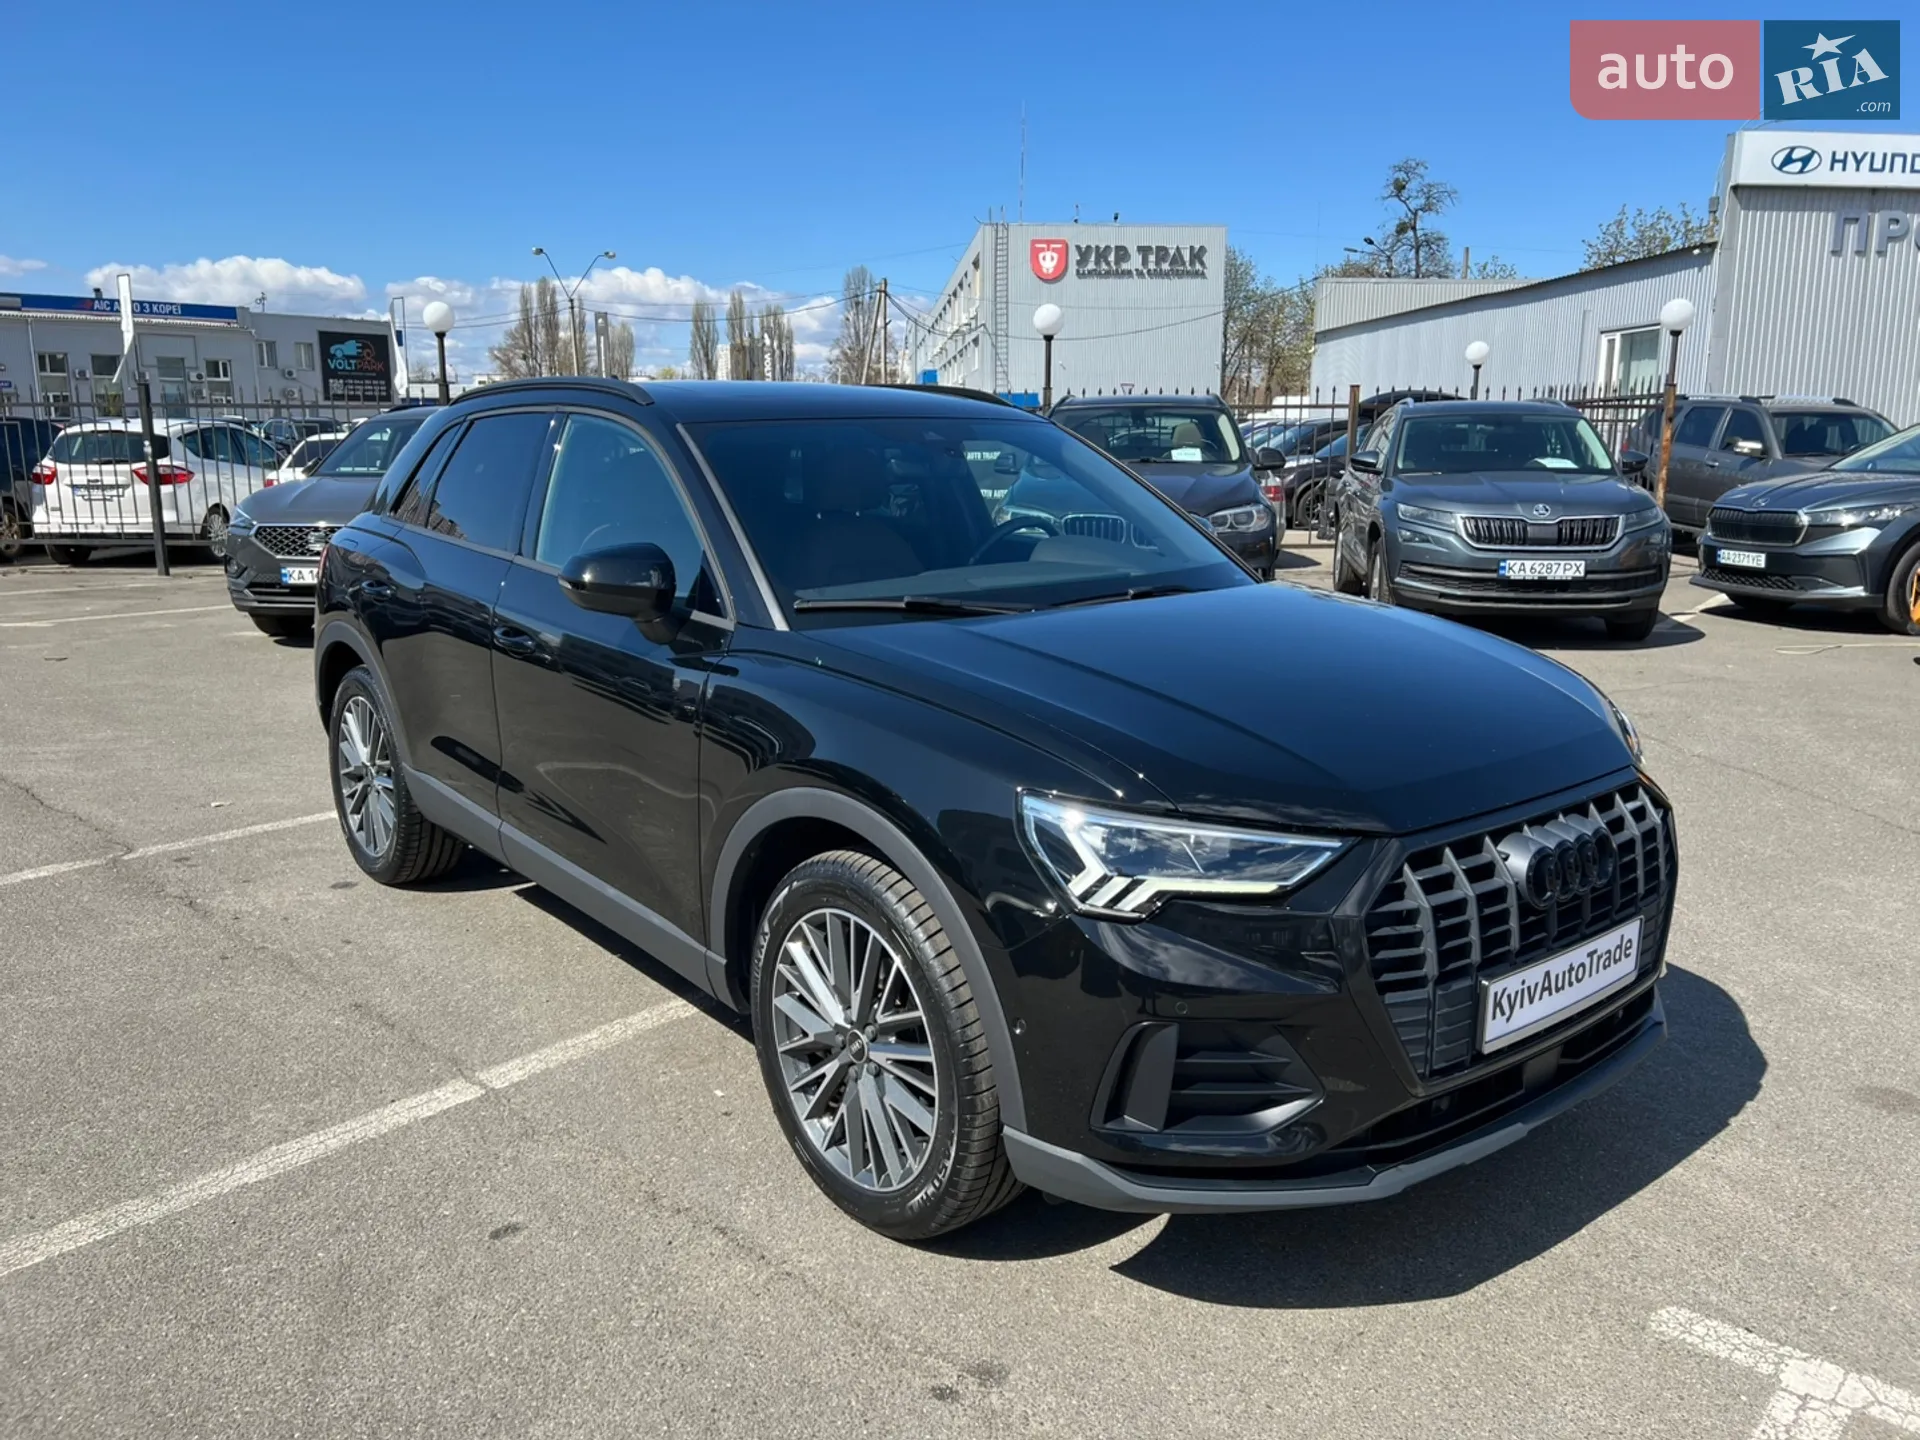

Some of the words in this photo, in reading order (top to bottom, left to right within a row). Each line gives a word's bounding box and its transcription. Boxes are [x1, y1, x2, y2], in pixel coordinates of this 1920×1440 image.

[1830, 208, 1920, 258] ПР
[1075, 244, 1131, 269] УКР
[1136, 245, 1208, 270] ТРАК
[1529, 562, 1561, 575] 6287
[1491, 933, 1634, 1024] KyivAutoTrade
